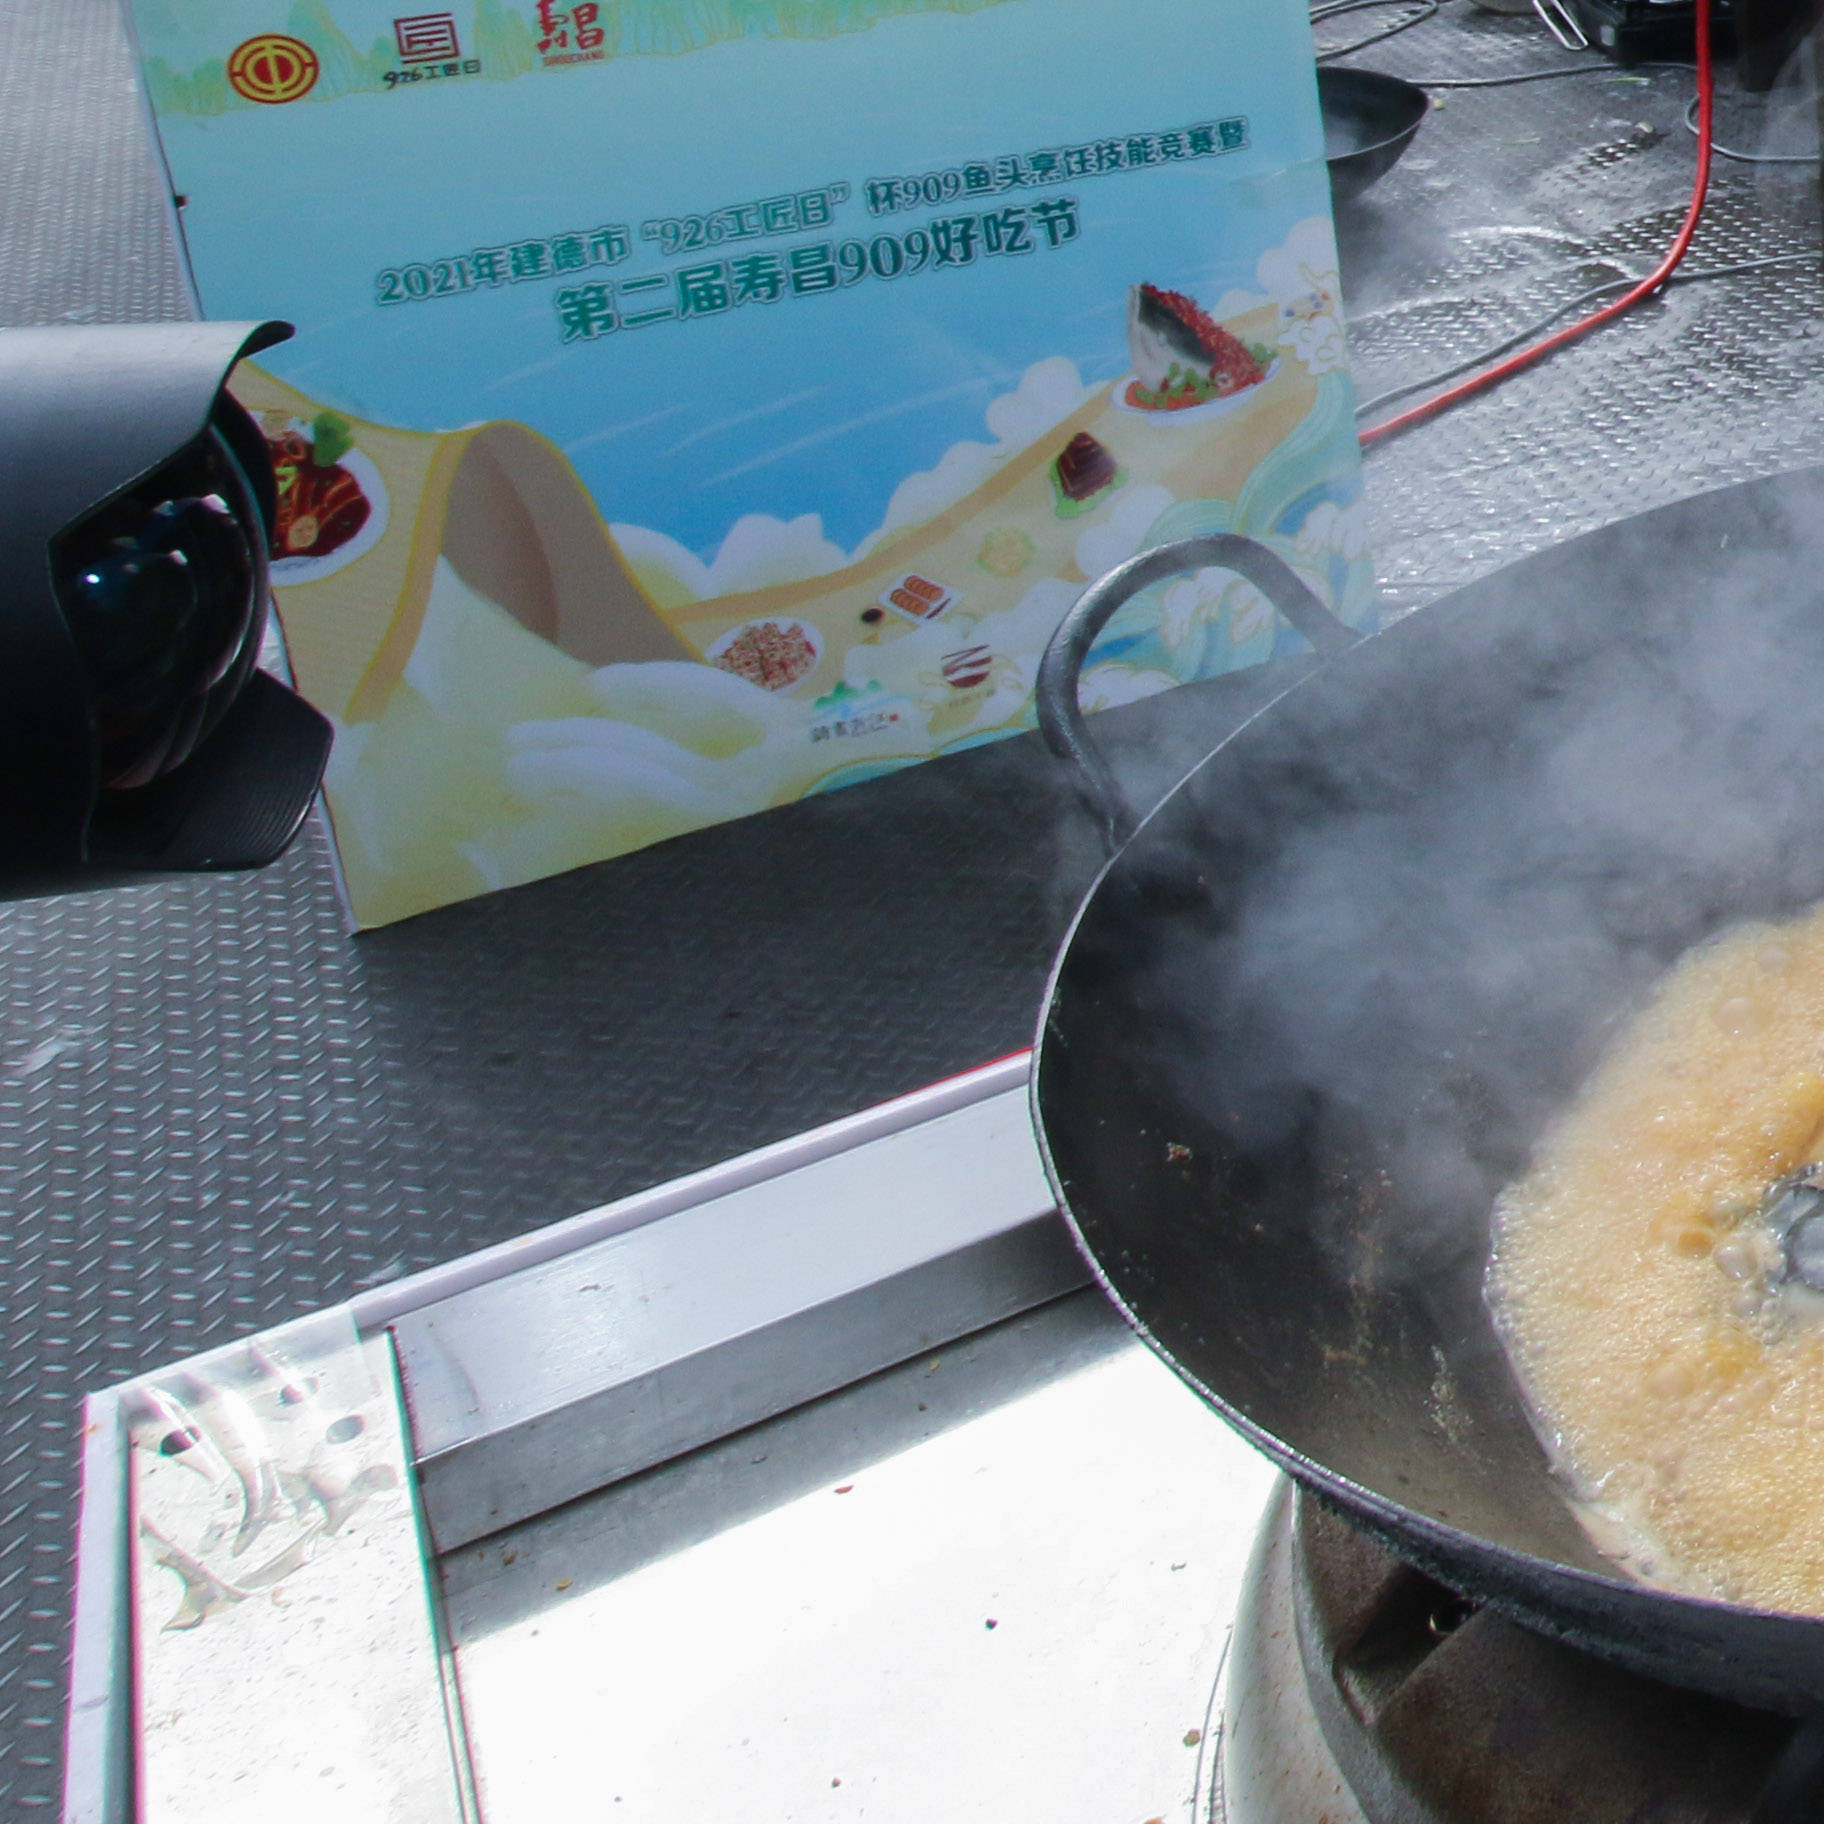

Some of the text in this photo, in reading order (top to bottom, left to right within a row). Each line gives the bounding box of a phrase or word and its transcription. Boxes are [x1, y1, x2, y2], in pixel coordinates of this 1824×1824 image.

[377, 225, 631, 306] 2021年建德市
[554, 196, 1082, 345] 第二届寿昌909好吃节
